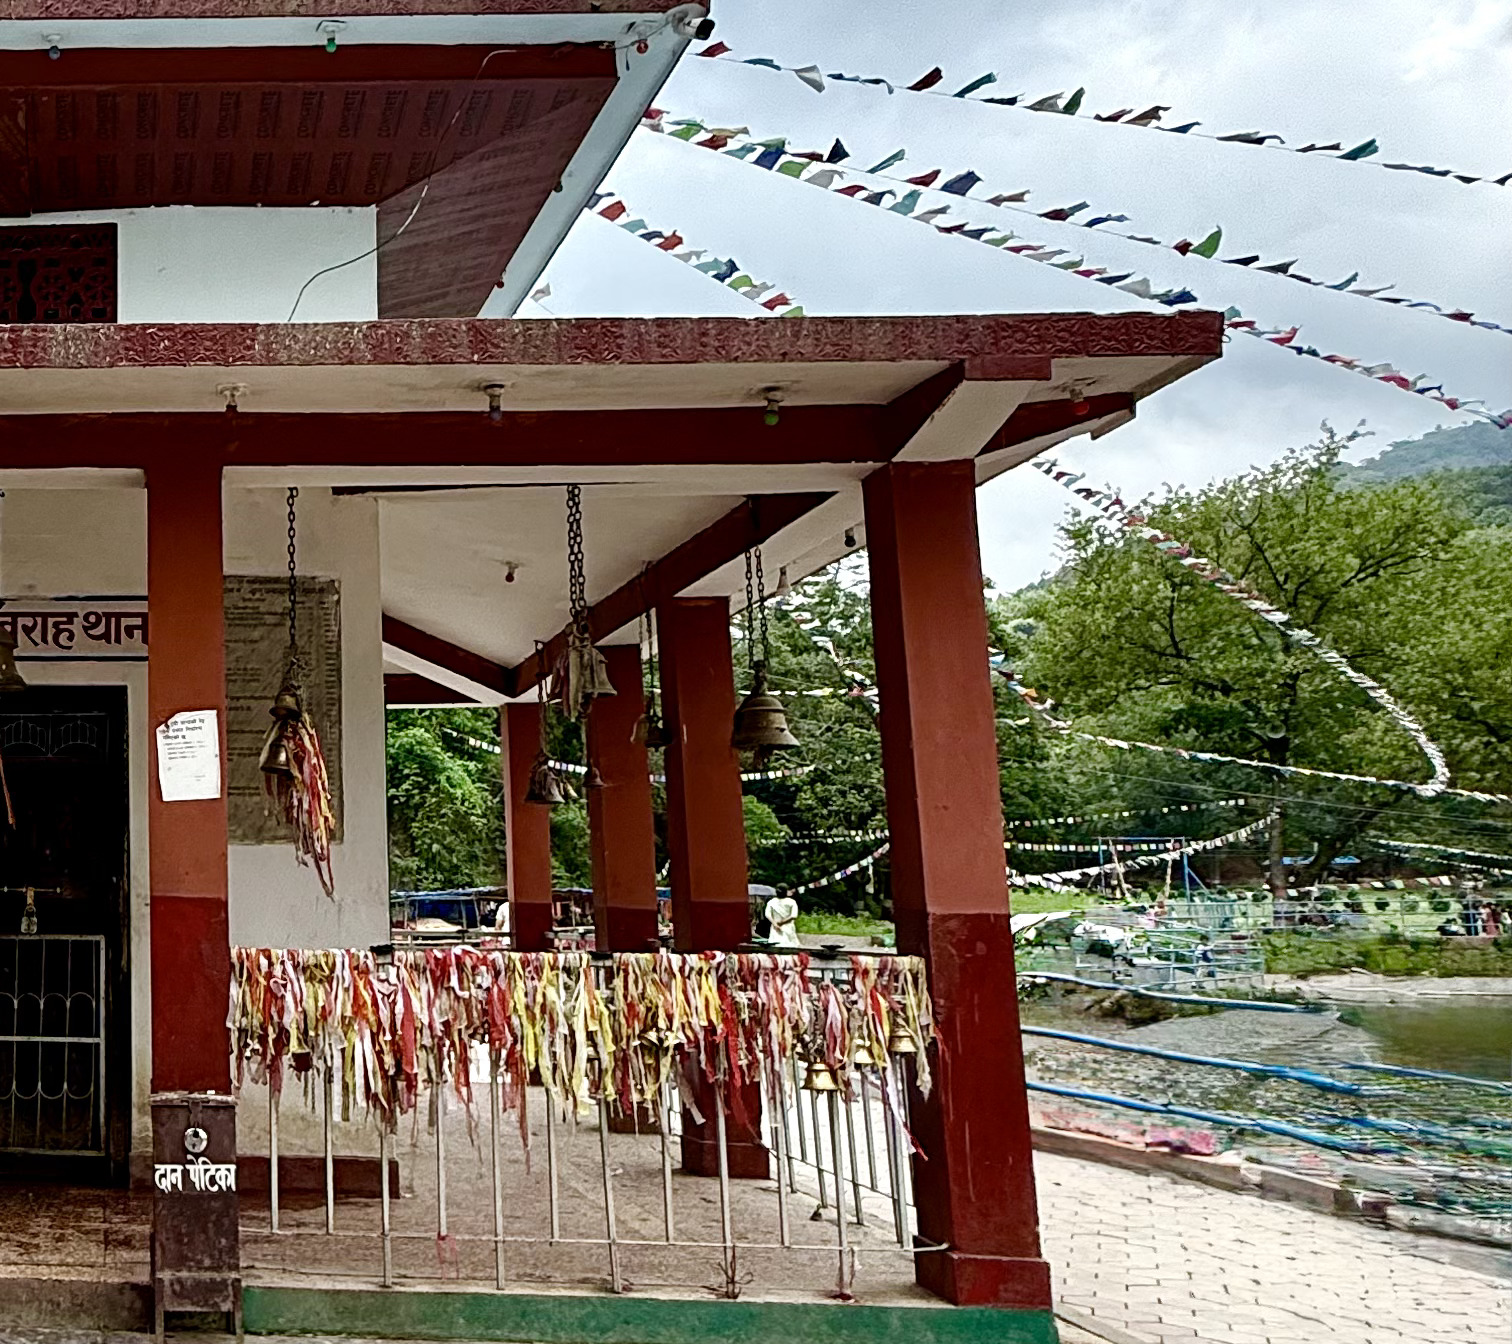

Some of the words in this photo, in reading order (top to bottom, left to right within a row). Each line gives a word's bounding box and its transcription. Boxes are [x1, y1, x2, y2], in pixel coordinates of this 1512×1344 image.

[82, 611, 148, 646] थान
[154, 1164, 184, 1194] दान
[185, 1154, 237, 1192] पेटिका
